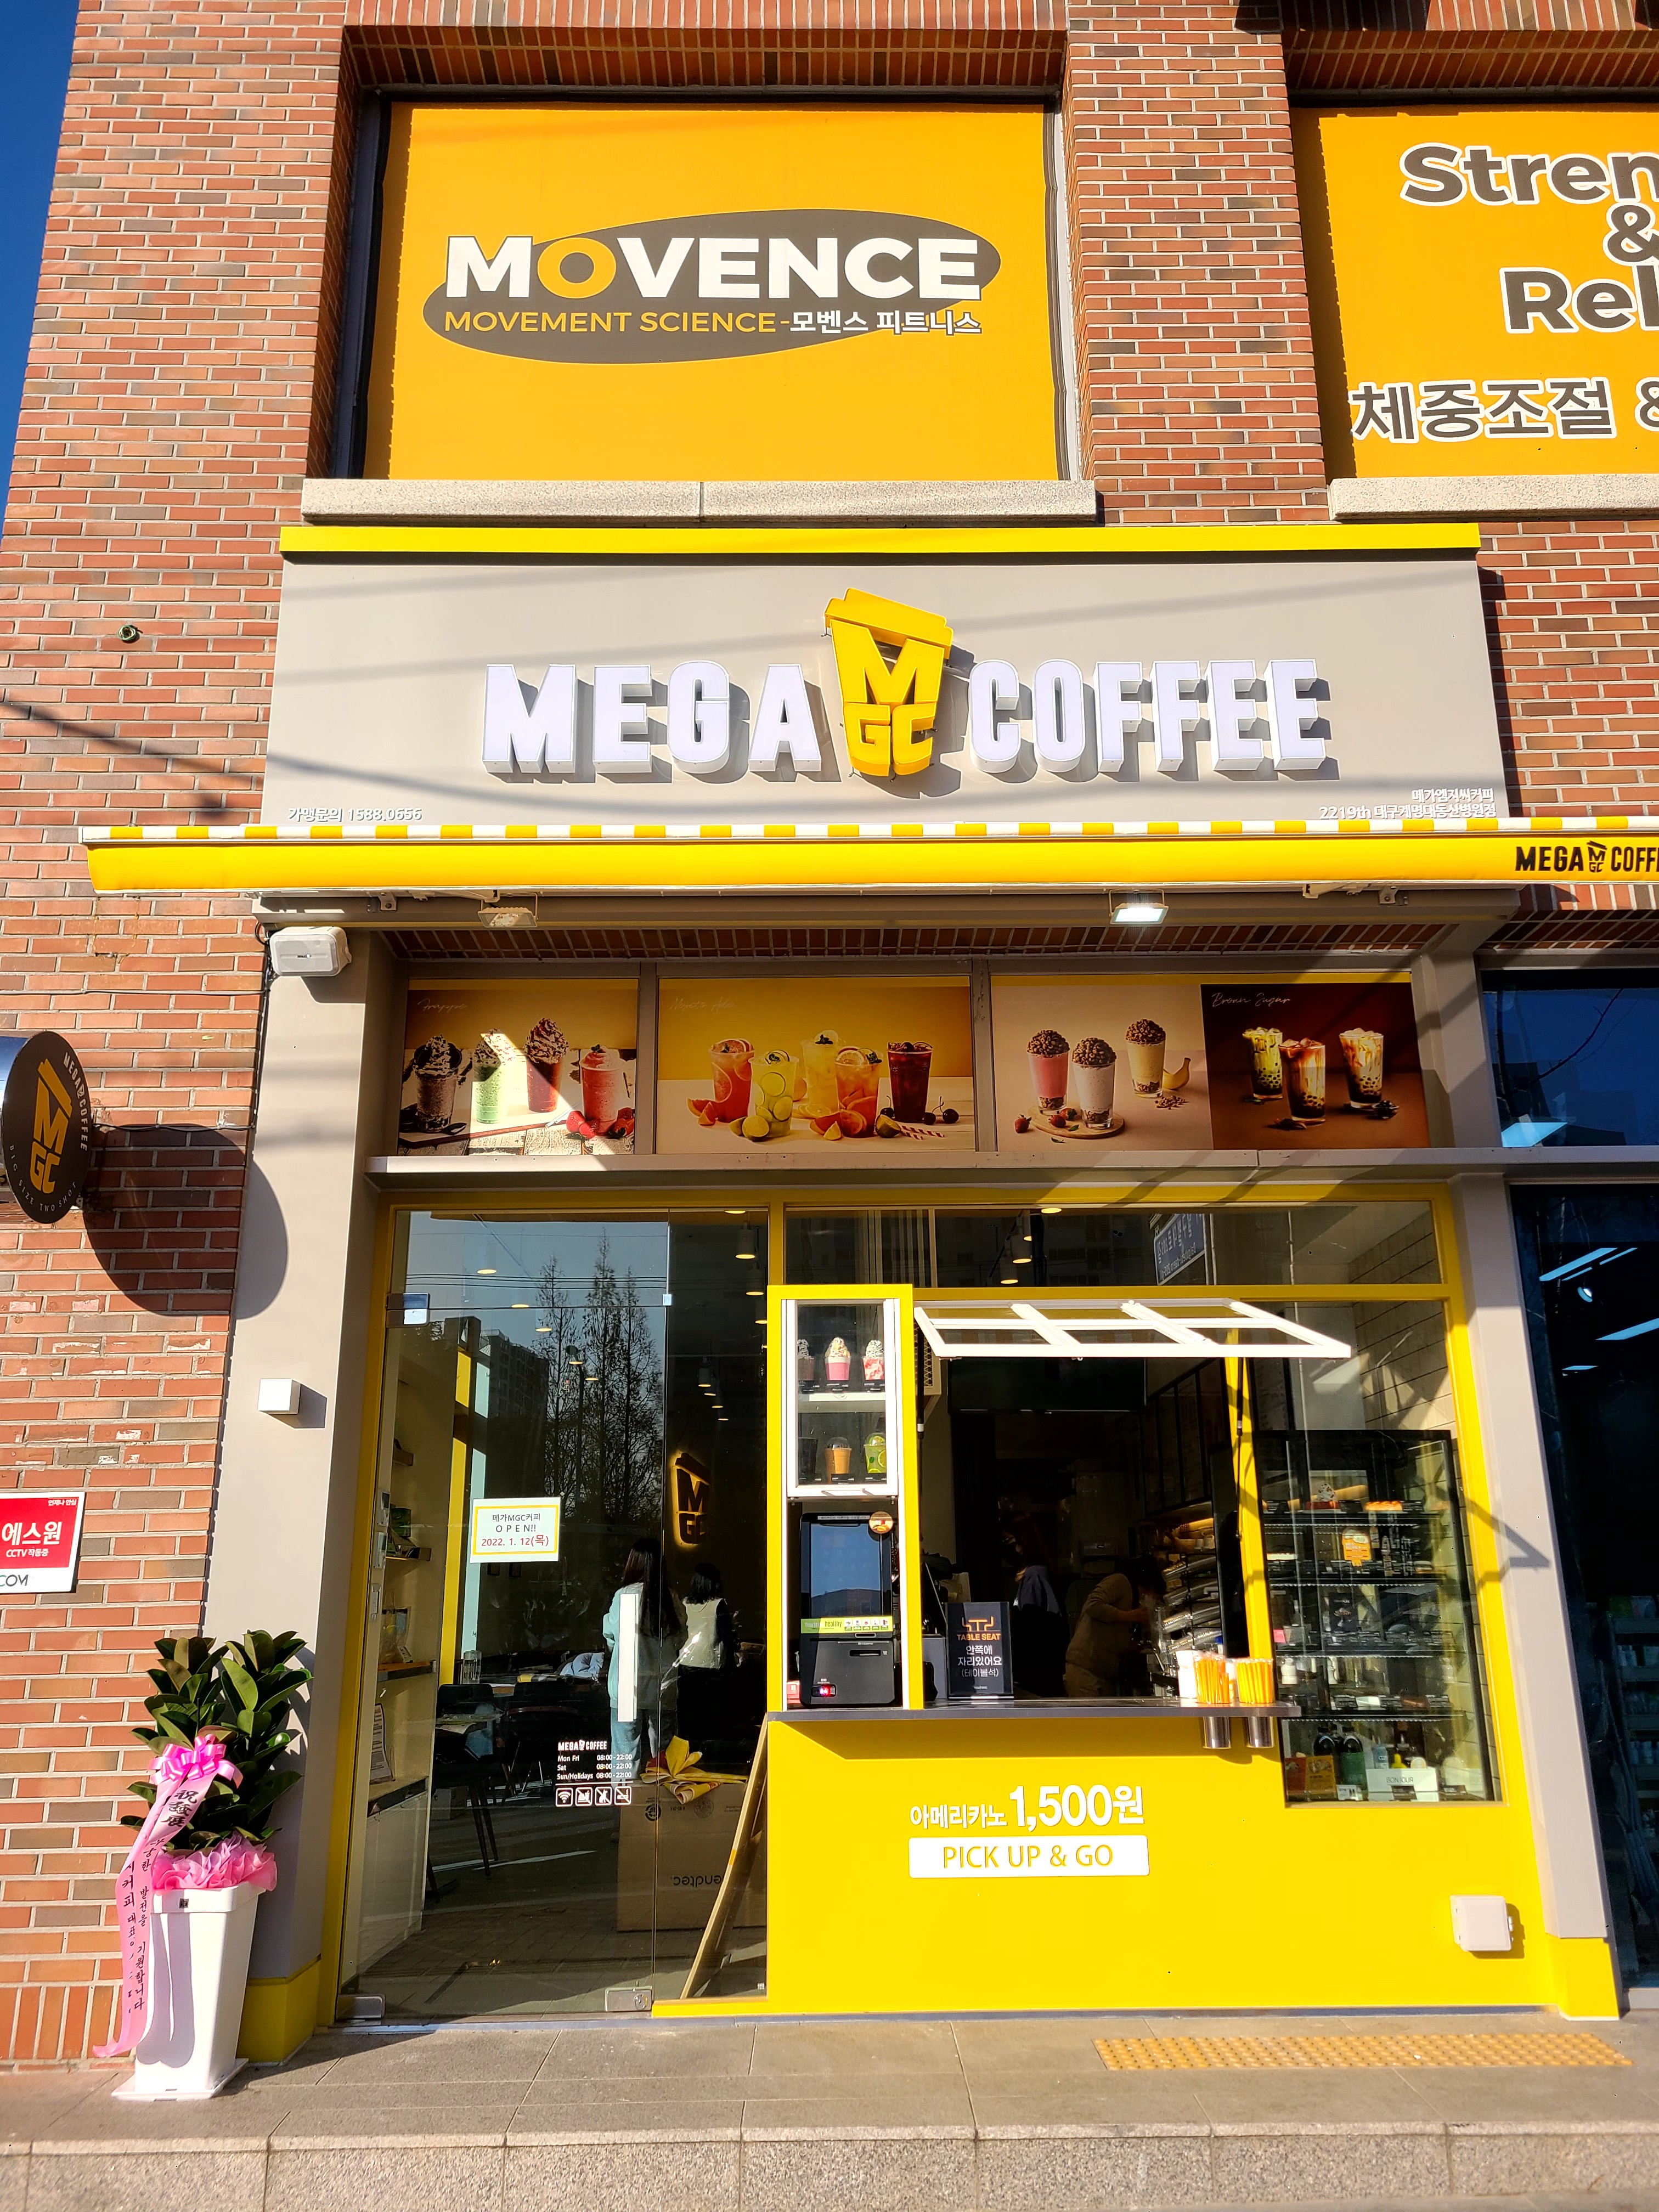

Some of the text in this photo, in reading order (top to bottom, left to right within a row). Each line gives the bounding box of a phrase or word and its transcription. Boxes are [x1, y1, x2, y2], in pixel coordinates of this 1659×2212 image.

[1402, 144, 1659, 204] Stren
[445, 235, 982, 301] MOVENCE
[1502, 264, 1659, 331] Rel
[444, 310, 632, 332] MOVEMENT
[876, 309, 982, 336] 피트니스
[1351, 380, 1613, 441] 체중조절
[481, 662, 823, 774] MEGA
[968, 659, 1328, 774] COFFEE
[1412, 788, 1494, 803] 메가엠지씨커피
[287, 807, 422, 822] 가맹문의 1588.0656
[1319, 803, 1497, 820] 2219th 대구계명대동산병원점
[1515, 846, 1584, 872] MEGA
[1611, 847, 1659, 872] COFF
[63, 1051, 81, 1091] MEGA
[79, 1098, 89, 1152] COFFEE
[19, 1179, 35, 1206] SIZE
[39, 1202, 55, 1212] TWO
[59, 1181, 77, 1207] SHOT
[492, 1513, 540, 1522] 메가MGC커피
[2, 1521, 63, 1545] 에스원
[481, 1538, 505, 1547] 2022.
[520, 1534, 549, 1547] 12(목)
[957, 1656, 1002, 1666] 자리있어요
[966, 1644, 992, 1655] 안쪽에
[961, 1668, 999, 1677] (테이블석)
[557, 1741, 579, 1751] MEGA
[585, 1741, 607, 1750] COFFEE
[910, 1784, 1145, 1832] 아메리카노 1,500원
[943, 1844, 1113, 1869] PICK UP & GO
[138, 1886, 149, 1927] 발전을
